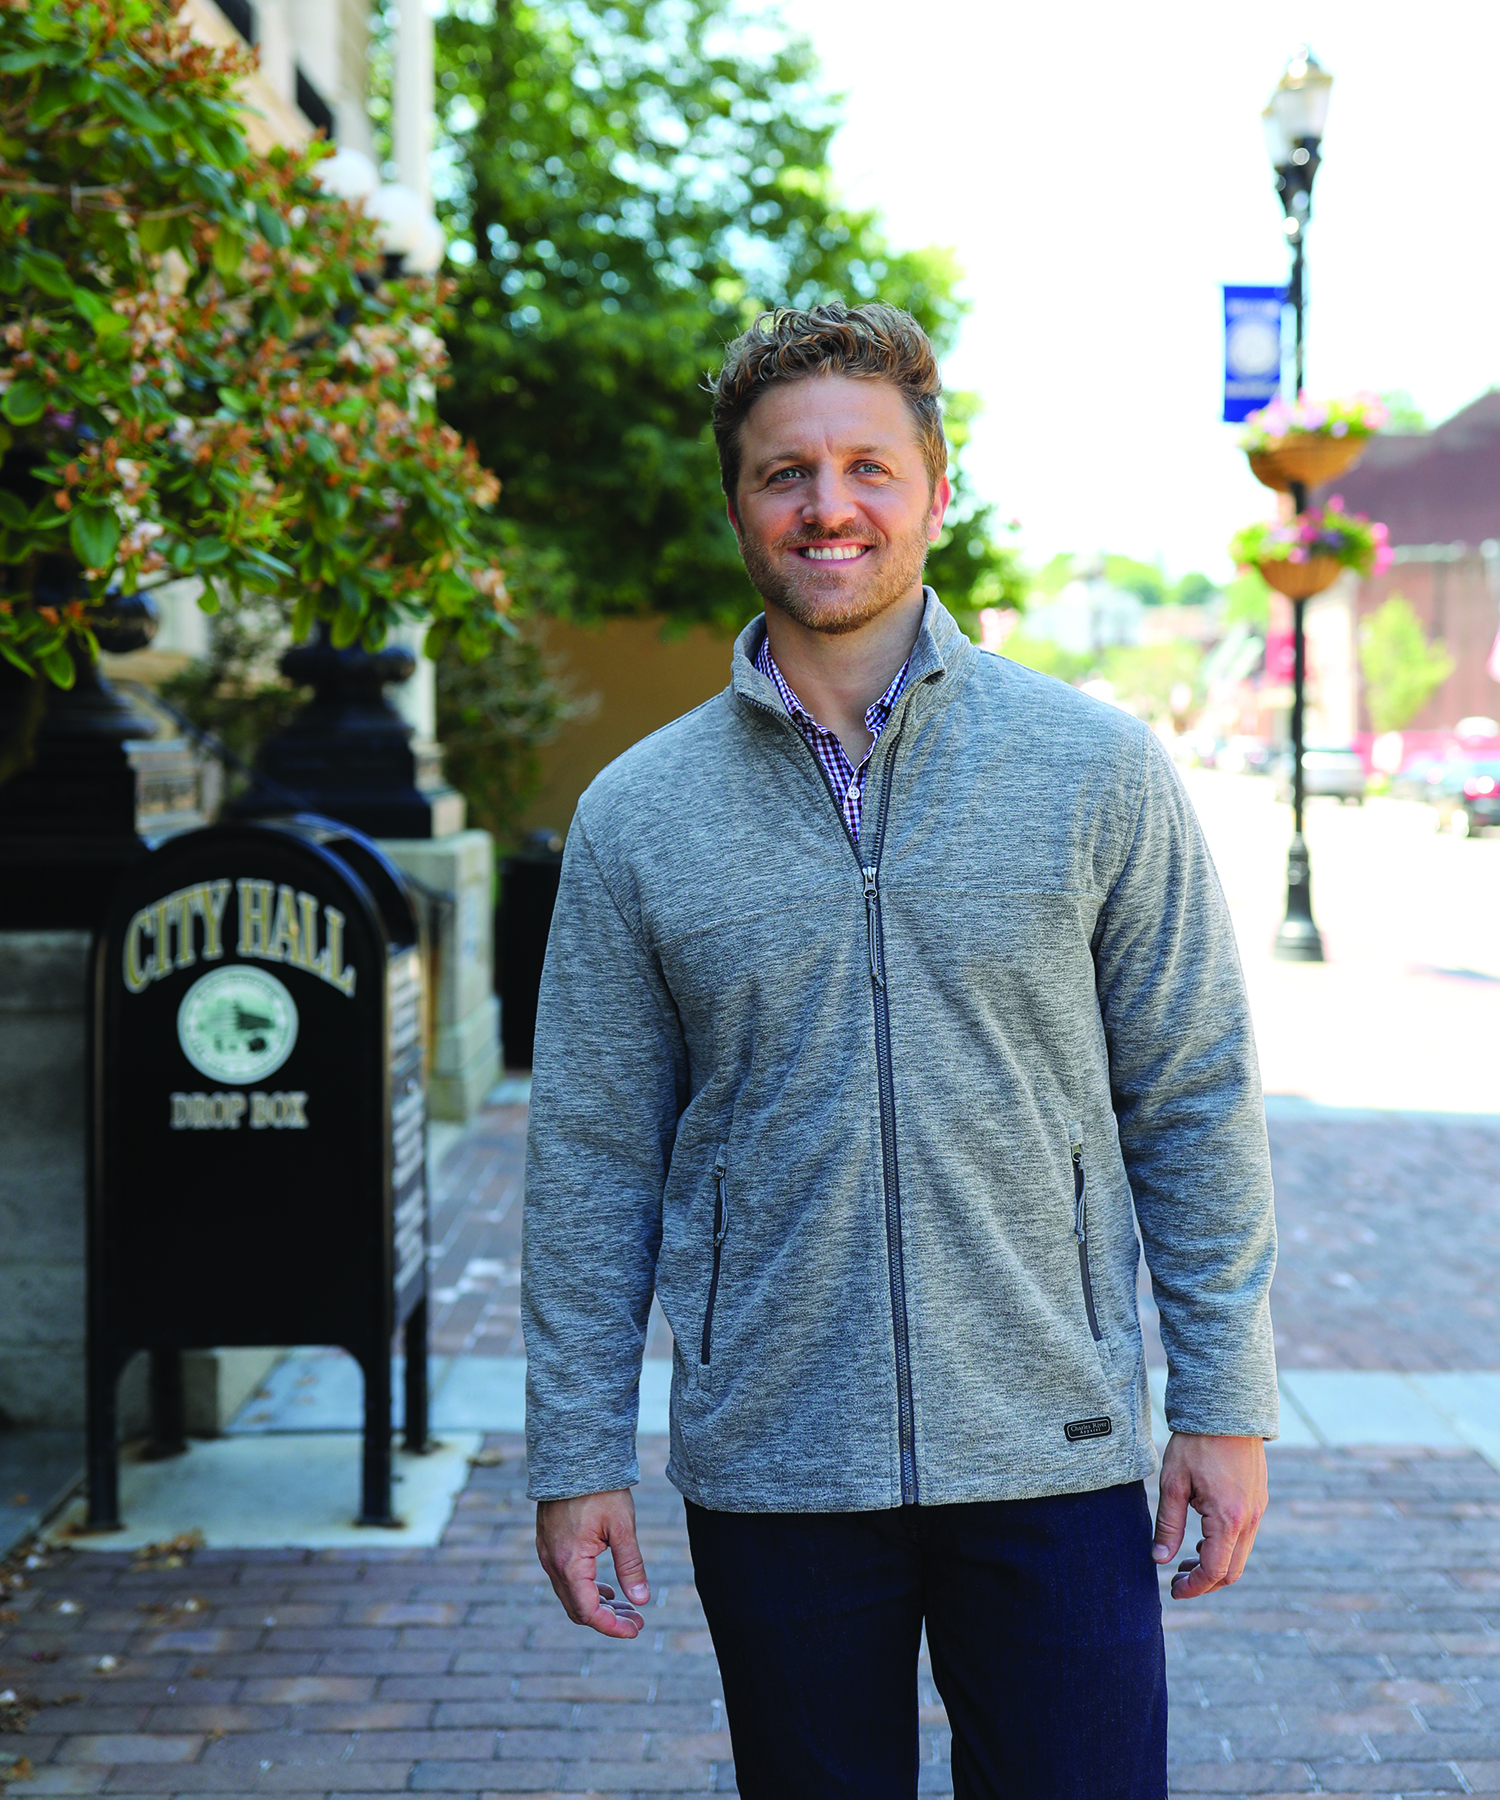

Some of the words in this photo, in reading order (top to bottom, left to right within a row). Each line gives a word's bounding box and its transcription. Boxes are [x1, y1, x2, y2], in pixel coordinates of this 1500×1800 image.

[122, 878, 231, 994] CITY
[236, 878, 357, 998] HALL
[170, 1091, 247, 1130] DROP
[249, 1091, 308, 1129] BOX
